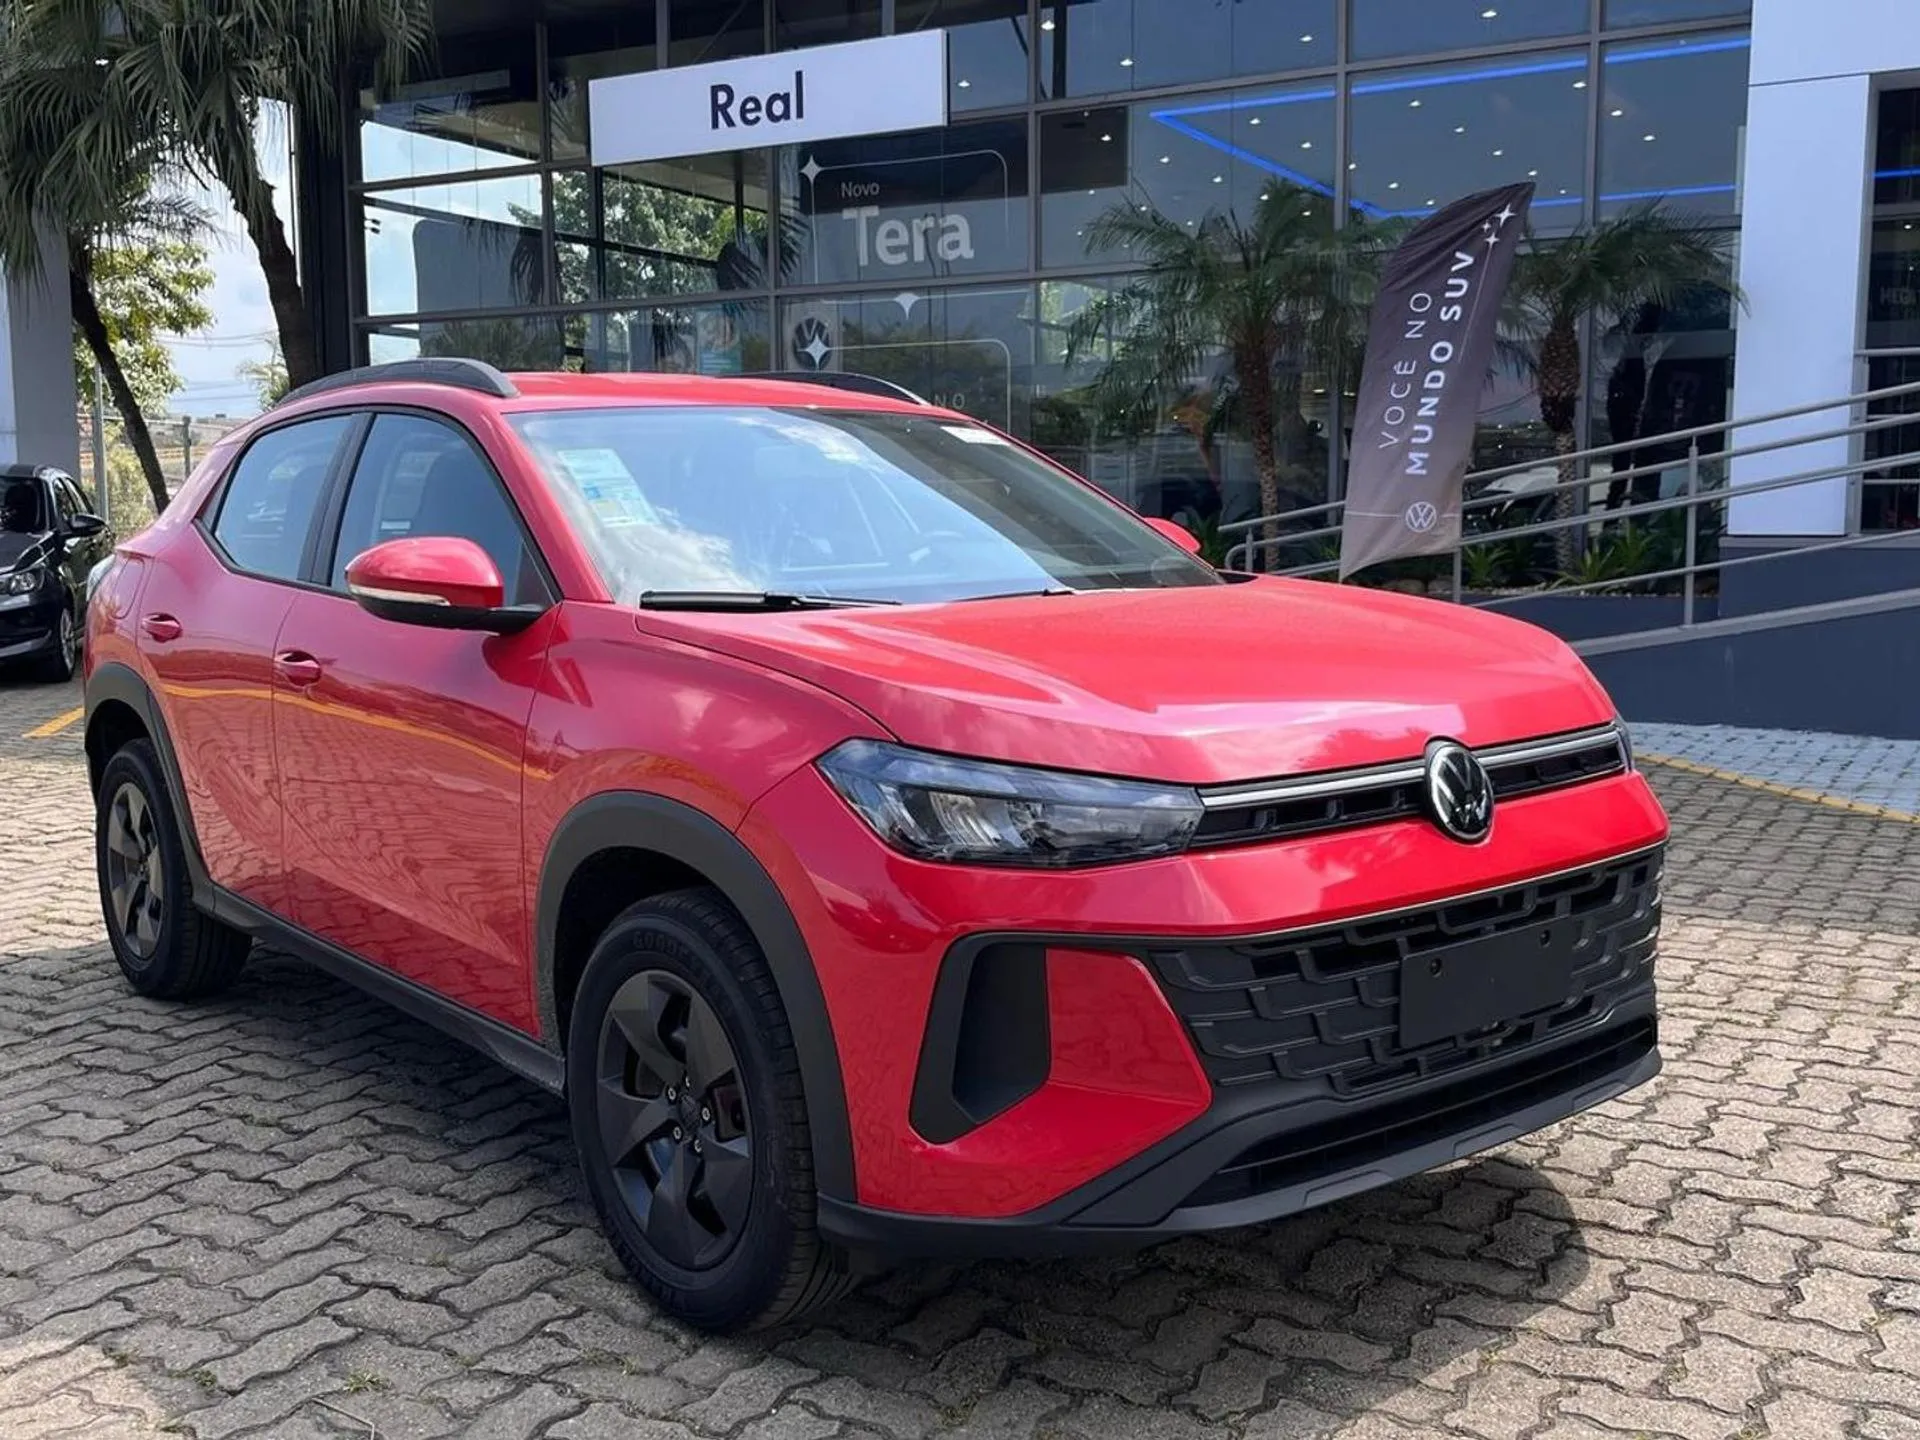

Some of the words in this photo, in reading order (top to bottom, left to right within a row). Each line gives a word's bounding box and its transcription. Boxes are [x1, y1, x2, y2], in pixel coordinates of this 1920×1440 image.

[710, 70, 804, 130] Real
[841, 181, 880, 199] Novo
[842, 206, 974, 267] Tera
[1379, 360, 1416, 448] VOCÊ
[1405, 293, 1432, 339] NO
[1405, 341, 1454, 475] MUNDO
[1440, 251, 1475, 321] SUV
